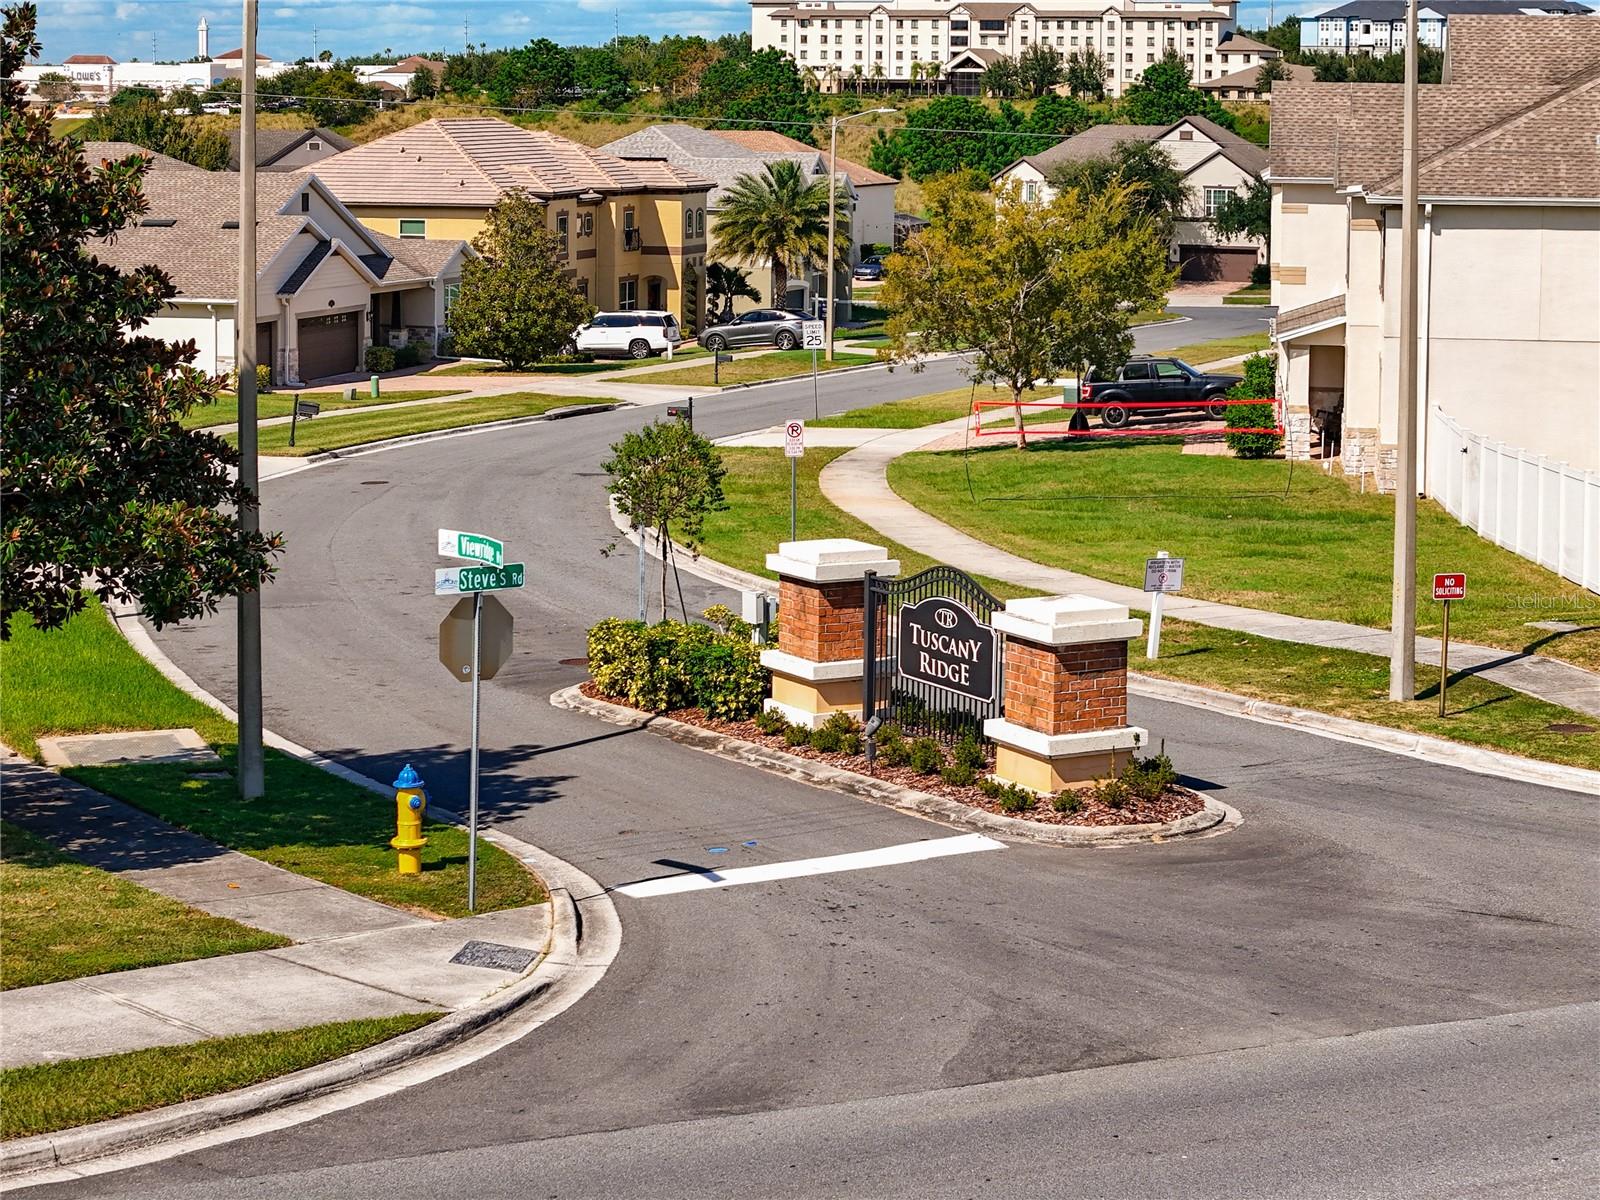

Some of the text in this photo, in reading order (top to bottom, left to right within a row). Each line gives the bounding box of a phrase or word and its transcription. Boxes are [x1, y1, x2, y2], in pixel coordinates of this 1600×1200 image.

[806, 335, 822, 346] 25
[512, 572, 523, 585] Rd
[1444, 578, 1455, 586] NO
[1435, 587, 1463, 595] SOLICITING
[939, 610, 953, 627] TR
[909, 622, 982, 662] TUSCANY
[920, 651, 970, 686] RIDGE
